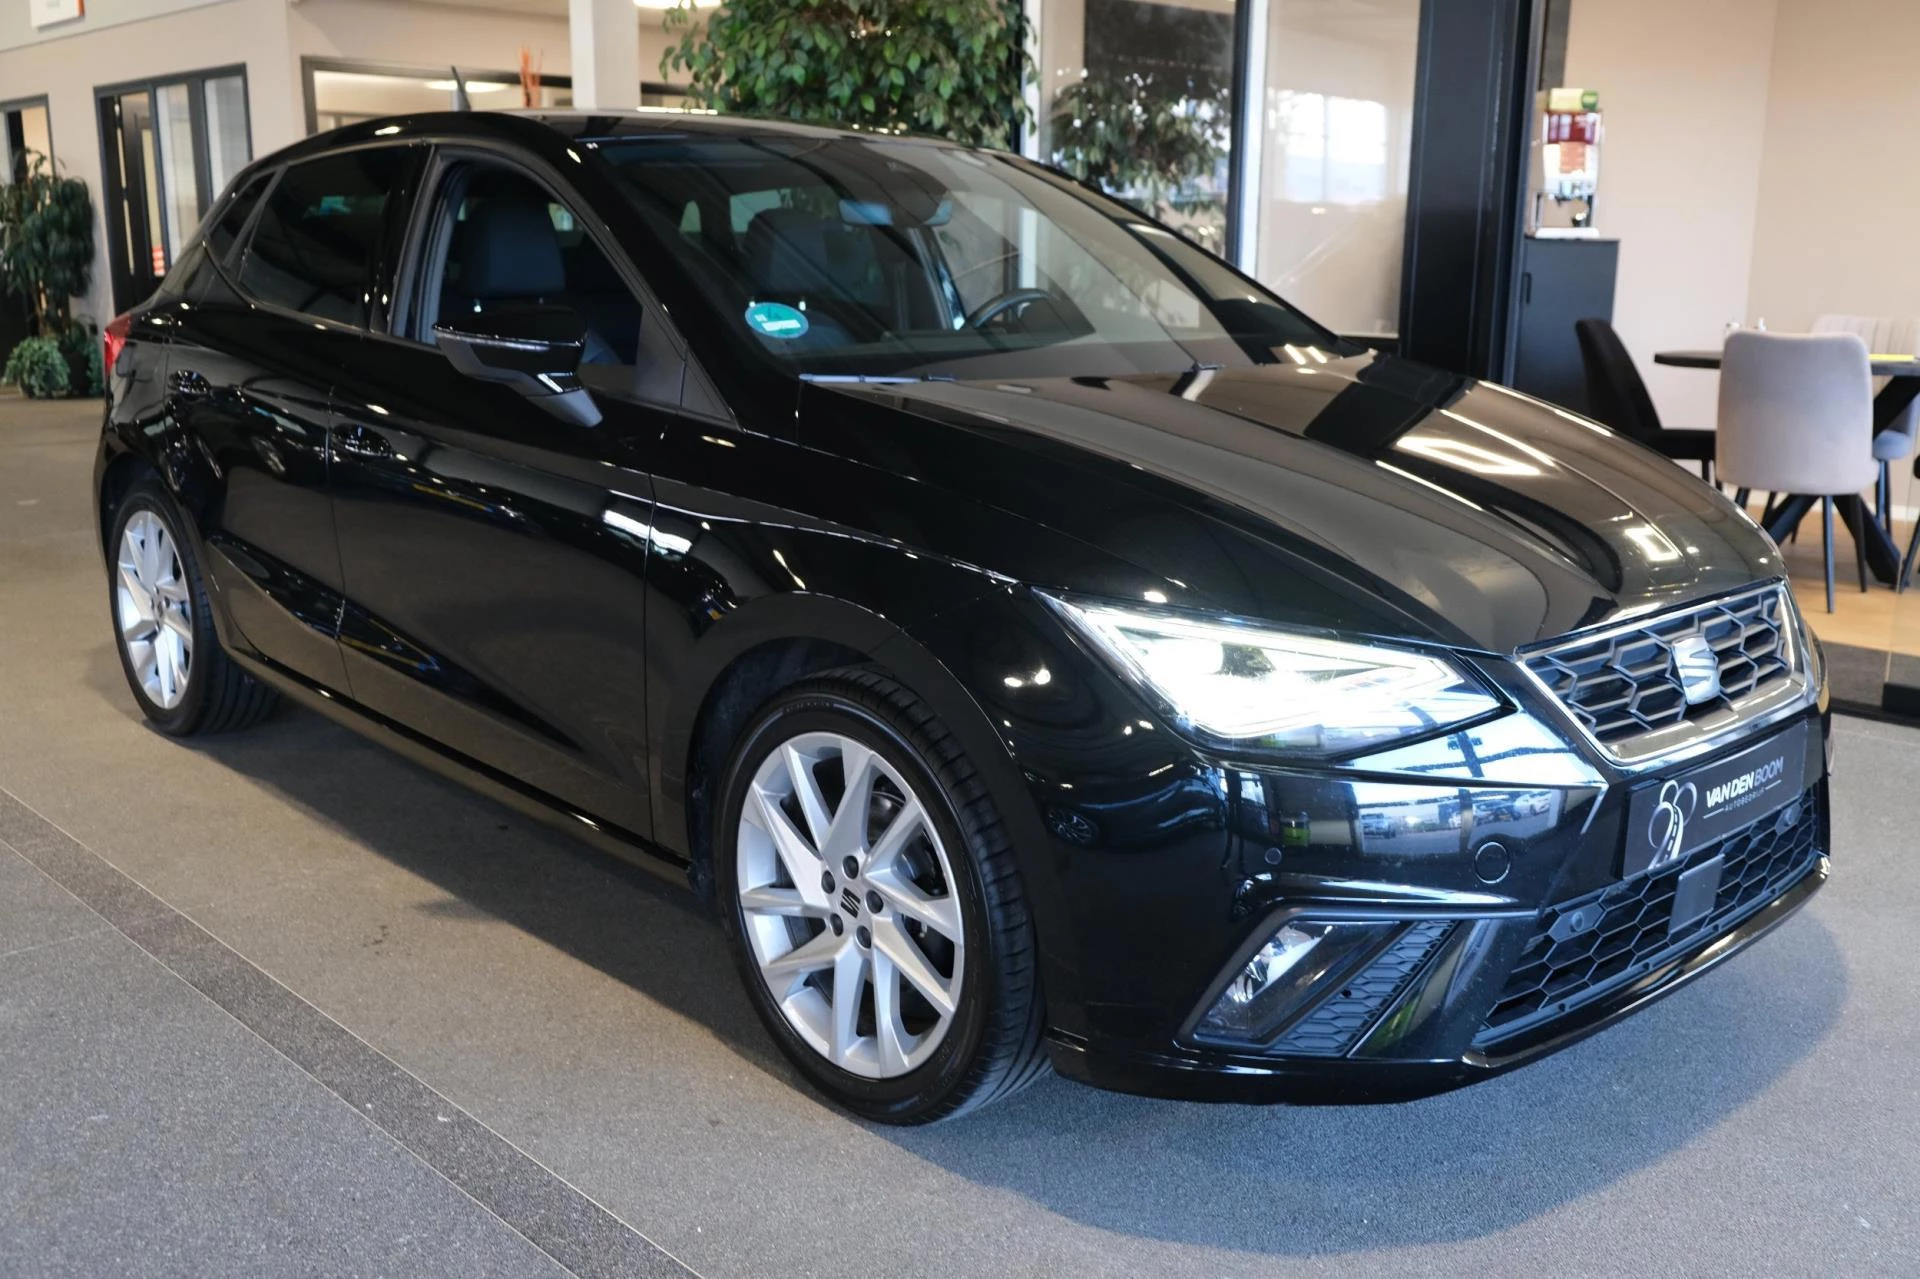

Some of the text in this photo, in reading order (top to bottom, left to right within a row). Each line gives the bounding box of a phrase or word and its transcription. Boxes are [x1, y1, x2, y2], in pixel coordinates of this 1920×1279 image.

[1706, 756, 1784, 808] VAN DEN BOOM
